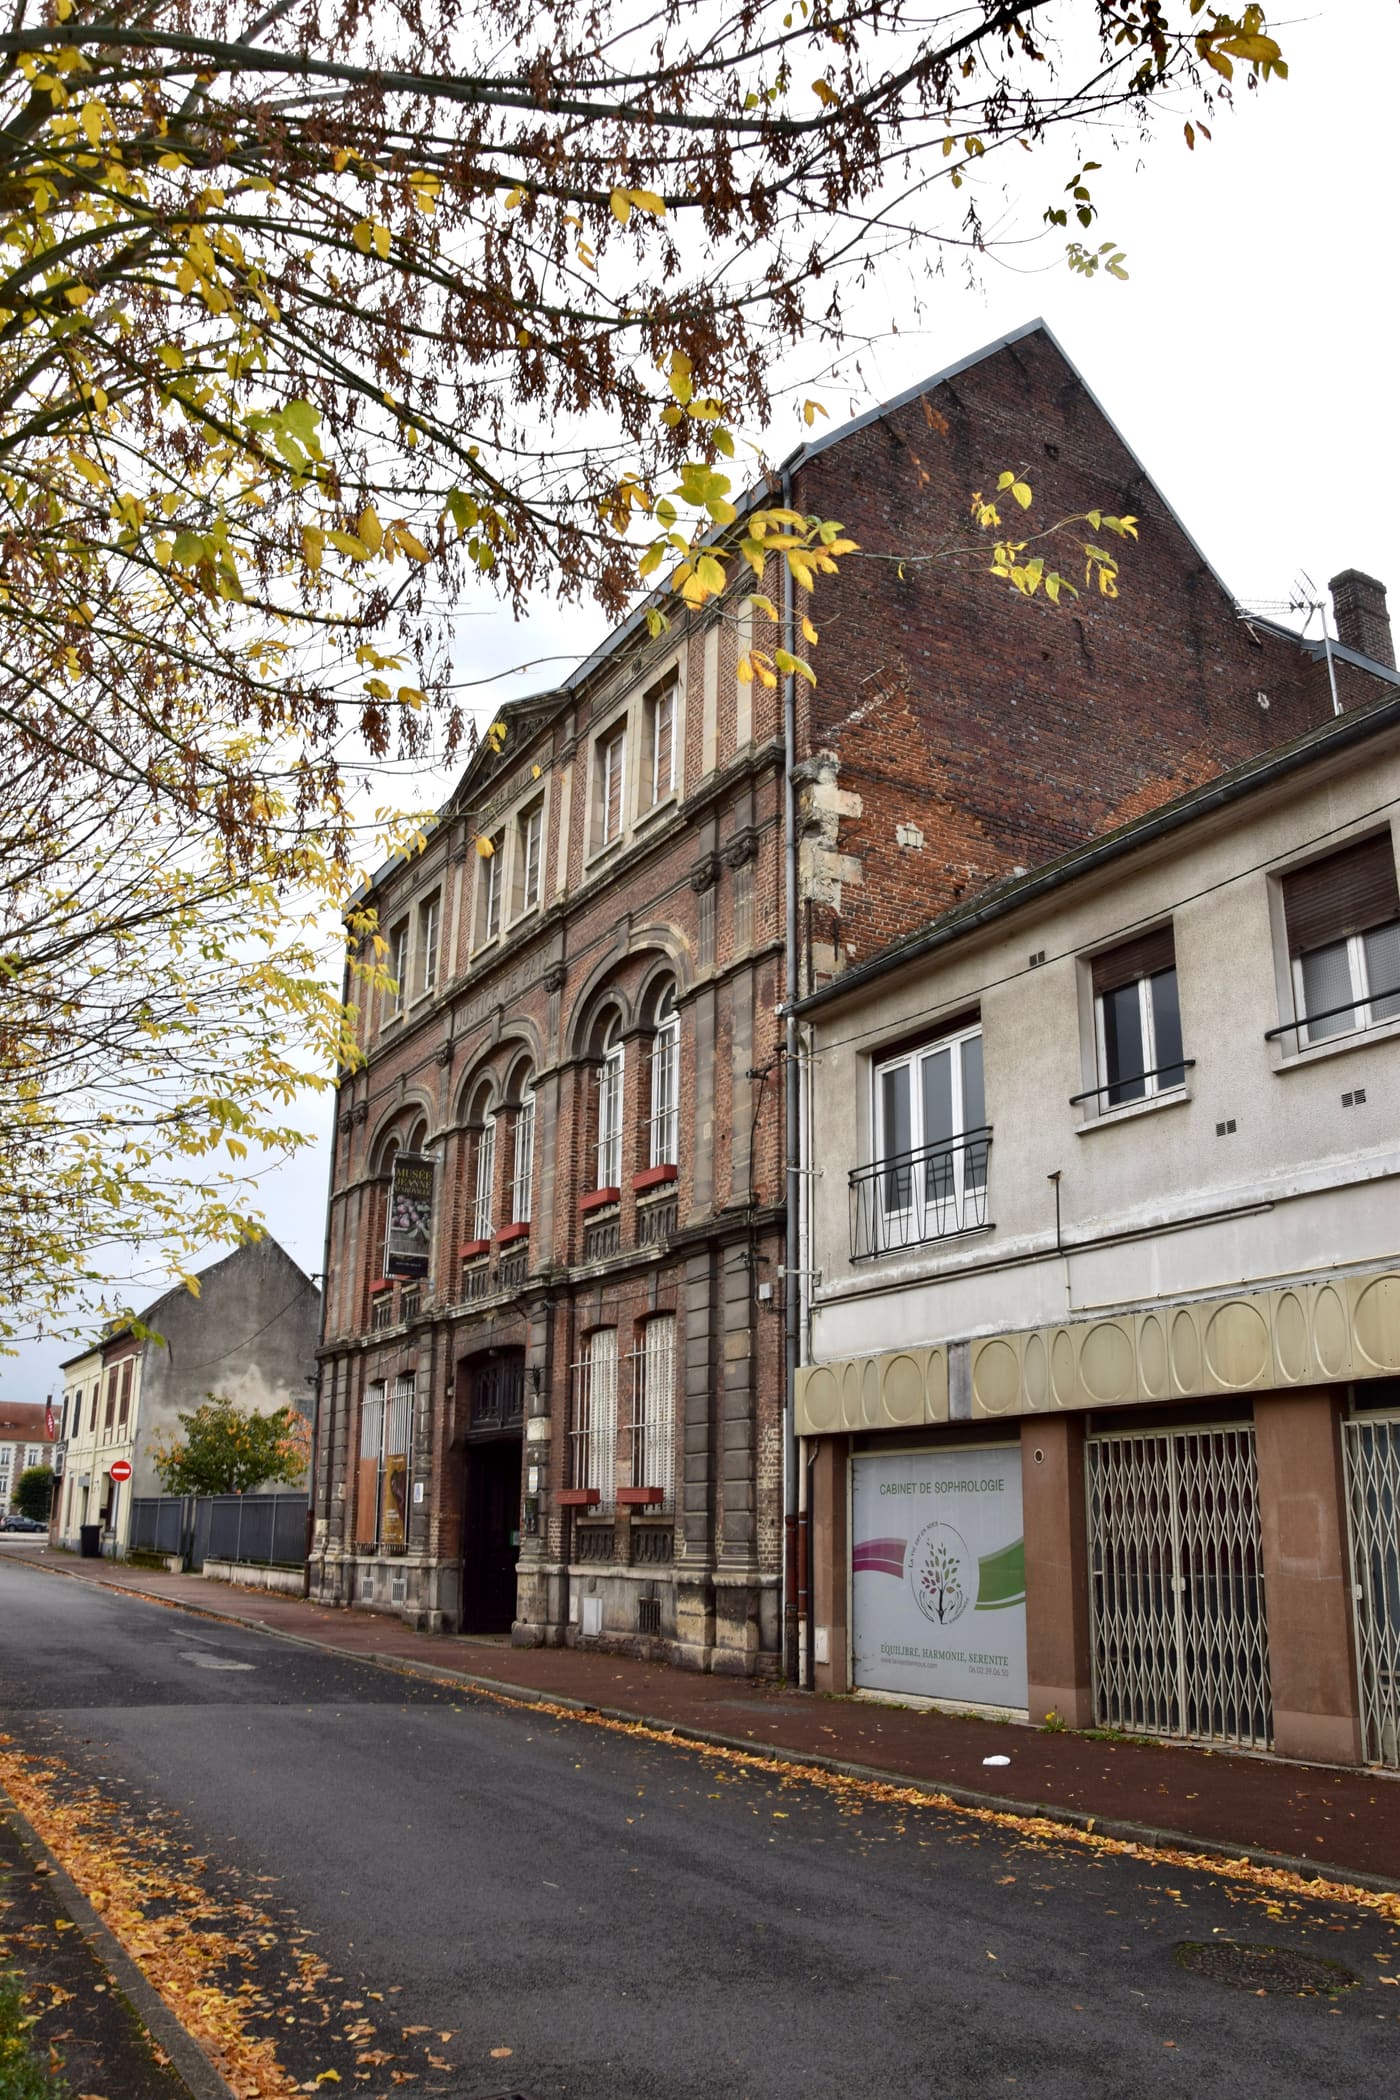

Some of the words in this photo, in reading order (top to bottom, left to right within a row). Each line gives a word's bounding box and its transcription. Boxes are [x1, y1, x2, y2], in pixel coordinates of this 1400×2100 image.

[457, 983, 502, 1030] JUSTICE
[503, 971, 519, 999] DE
[524, 945, 552, 982] PAIX
[879, 1483, 918, 1495] CABINET
[919, 1482, 932, 1494] DE
[934, 1479, 1005, 1494] SOPHROLOGIE
[922, 1648, 967, 1663] HARMONIE,
